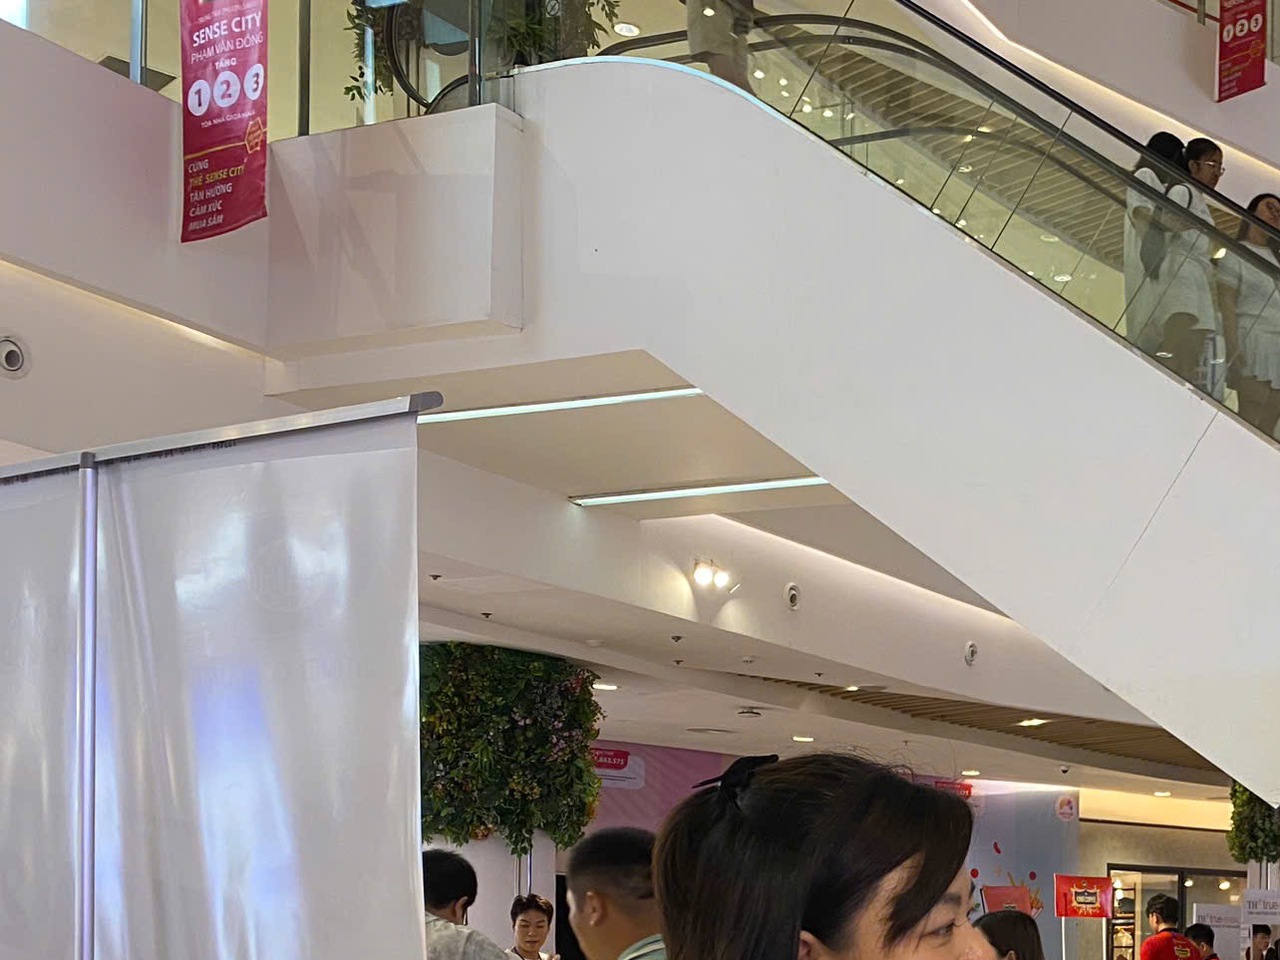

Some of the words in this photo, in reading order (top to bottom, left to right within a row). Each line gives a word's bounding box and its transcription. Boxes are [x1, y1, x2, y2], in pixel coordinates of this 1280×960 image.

[193, 20, 228, 47] SENSE
[231, 11, 261, 32] CITY
[194, 87, 202, 107] 1
[220, 79, 232, 100] 2
[252, 72, 260, 93] 3
